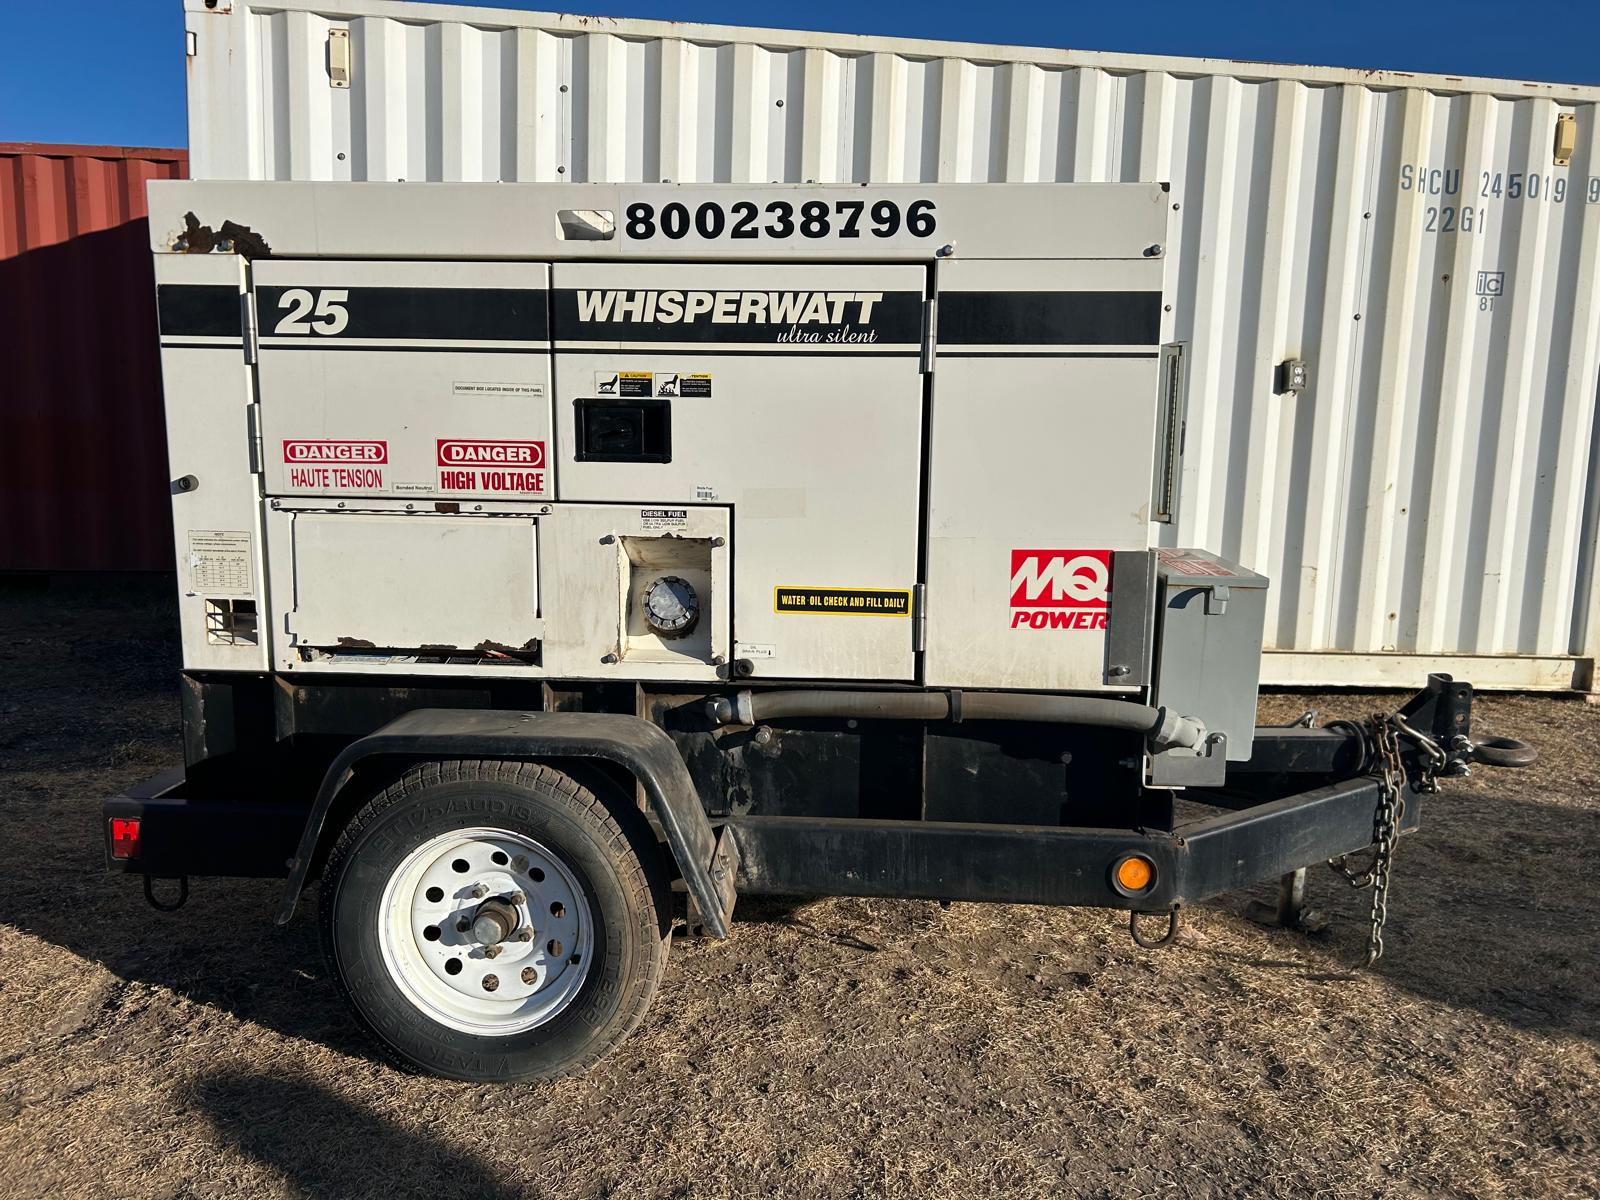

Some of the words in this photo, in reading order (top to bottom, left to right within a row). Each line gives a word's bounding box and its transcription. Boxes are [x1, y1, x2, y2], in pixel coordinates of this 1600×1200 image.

[1401, 164, 1460, 195] SHCU
[1481, 171, 1567, 204] 245019
[1588, 178, 1600, 204] 9
[625, 199, 937, 240] 800238796
[1425, 206, 1485, 234] 22G1
[274, 288, 349, 335] 25
[576, 290, 883, 325] WHISPERWATT
[1479, 297, 1494, 312] 81
[776, 324, 823, 344] ultra
[825, 324, 879, 344] silent
[294, 445, 378, 459] DANGER
[451, 446, 532, 462] DANGER
[291, 468, 330, 488] HAUTE
[332, 469, 383, 488] TENSION
[440, 470, 476, 490] HIGH
[480, 471, 544, 492] VOLTAGE
[1010, 555, 1109, 602] MQ
[781, 594, 806, 605] WATER
[809, 596, 822, 606] OIL
[823, 596, 848, 606] CHECK
[849, 596, 865, 607] AND
[866, 597, 883, 608] FILL
[884, 598, 905, 608] DAILY
[1011, 610, 1109, 630] POWER
